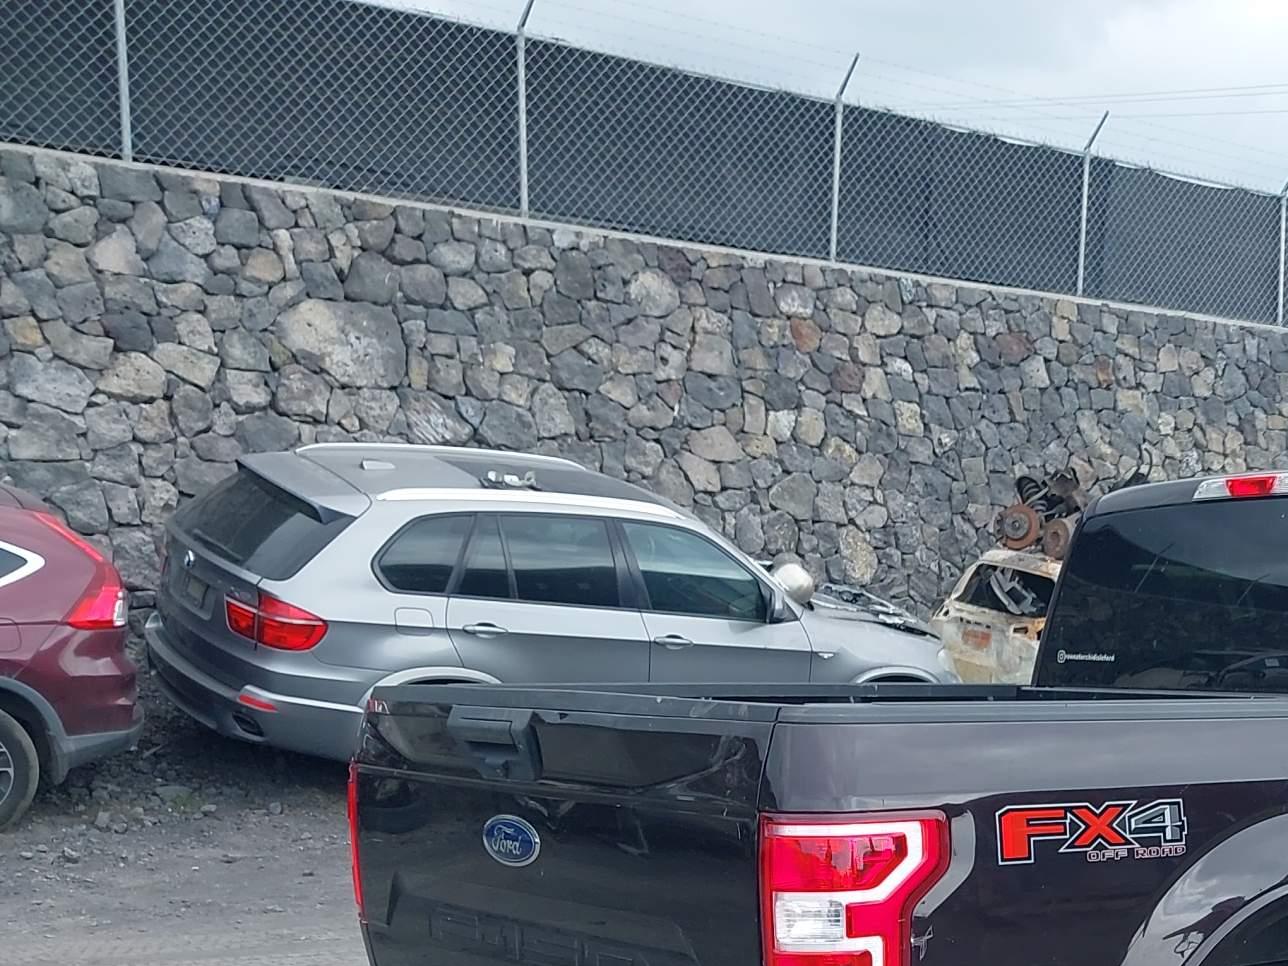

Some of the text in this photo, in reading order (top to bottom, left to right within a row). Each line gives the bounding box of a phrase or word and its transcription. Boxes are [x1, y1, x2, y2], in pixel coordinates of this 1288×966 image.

[491, 825, 522, 855] Ford
[995, 798, 1187, 865] FX4
[1087, 845, 1187, 862] OFF ROAD
